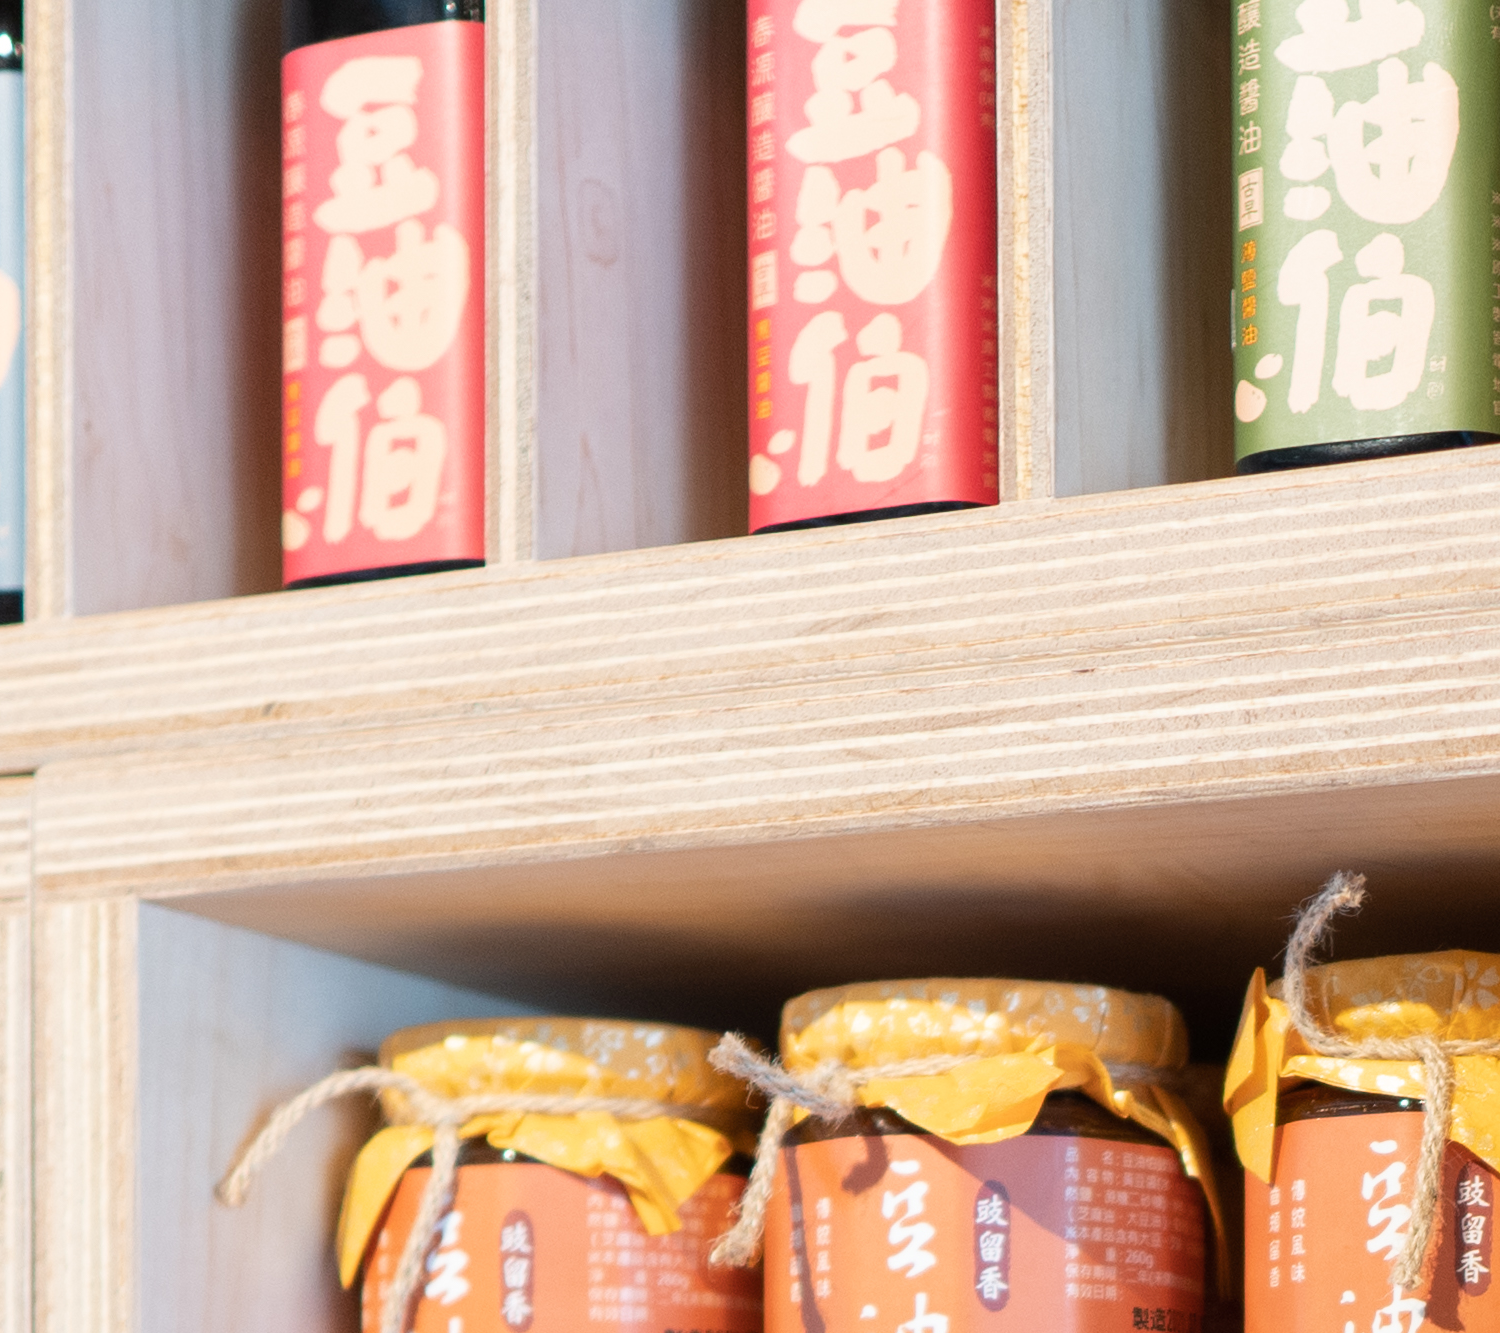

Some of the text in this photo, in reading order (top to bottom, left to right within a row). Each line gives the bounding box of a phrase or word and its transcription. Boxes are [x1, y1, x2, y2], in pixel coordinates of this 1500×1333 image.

[313, 56, 470, 542] 豆油伯
[975, 1194, 1010, 1301] 豉留香
[1457, 1176, 1490, 1285] 豉留香
